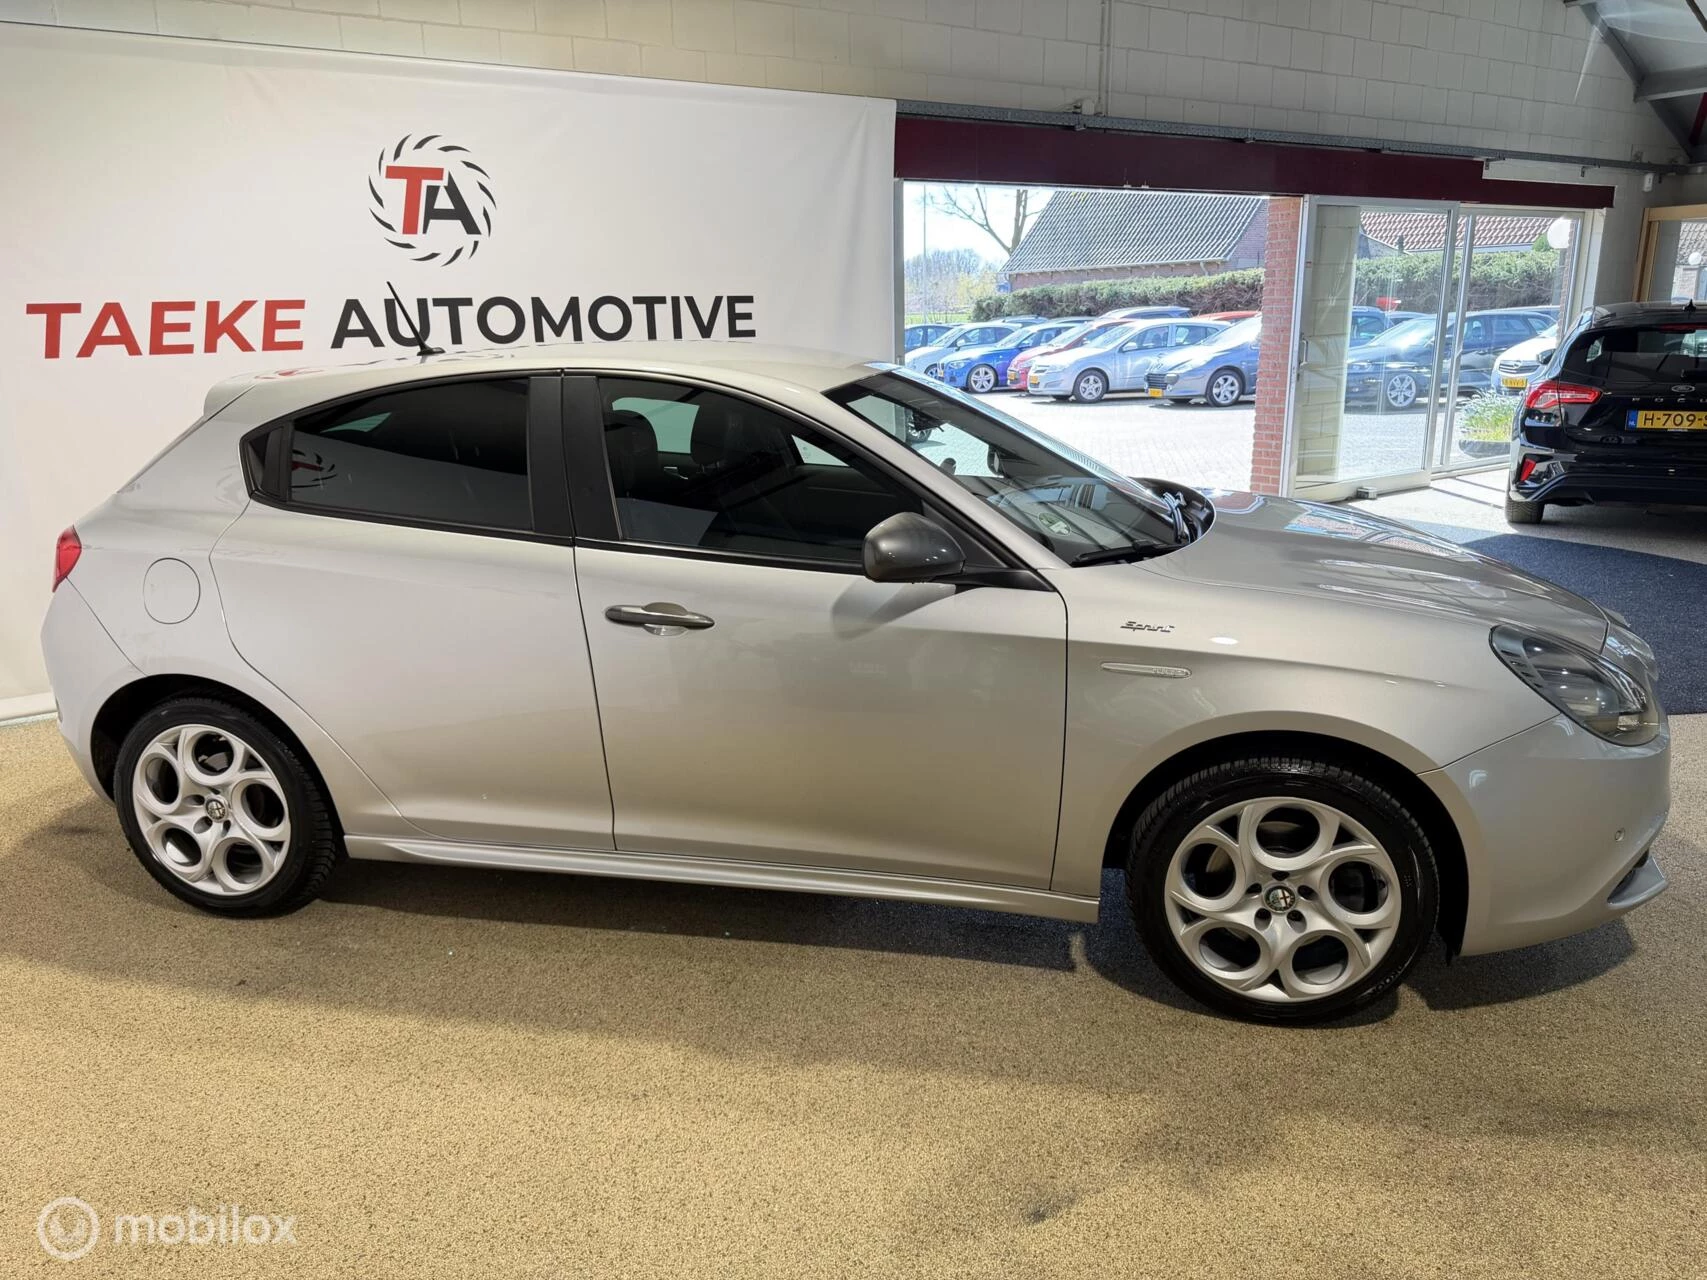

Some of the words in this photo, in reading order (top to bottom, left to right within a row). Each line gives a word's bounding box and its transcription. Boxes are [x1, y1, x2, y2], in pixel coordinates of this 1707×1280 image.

[385, 165, 482, 235] TA
[26, 299, 306, 359] TAEKE
[330, 295, 757, 349] AUTOMOTIVE
